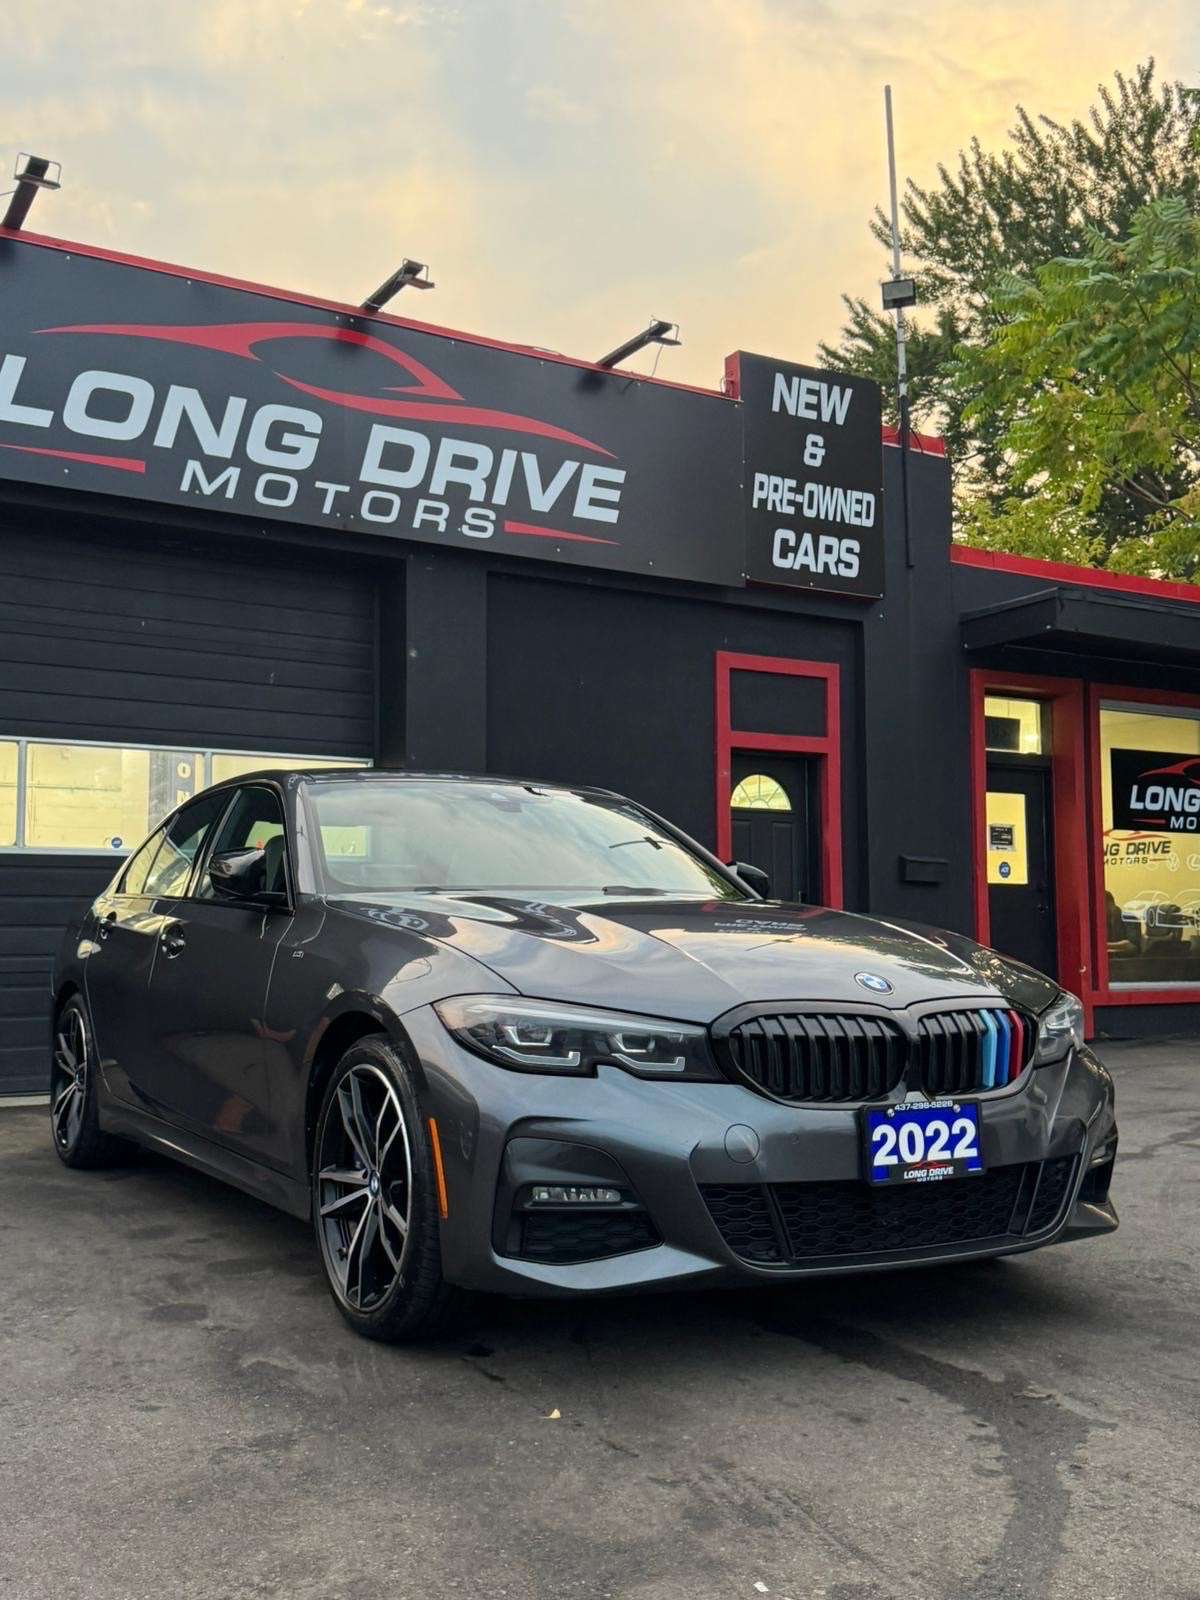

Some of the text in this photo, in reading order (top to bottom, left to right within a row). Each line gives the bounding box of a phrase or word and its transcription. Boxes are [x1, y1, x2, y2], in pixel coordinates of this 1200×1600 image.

[772, 372, 853, 426] NEW
[0, 354, 627, 524] LONG DRIVE
[803, 433, 826, 468] &
[179, 459, 498, 539] MOTORS
[752, 472, 876, 528] PRE-OWNED
[772, 528, 861, 578] CARS
[1129, 785, 1200, 813] LONG
[1169, 816, 1200, 830] MO
[1126, 840, 1171, 856] DRIVE
[872, 1118, 978, 1167] 2022
[903, 1166, 954, 1180] LONG DRIVE
